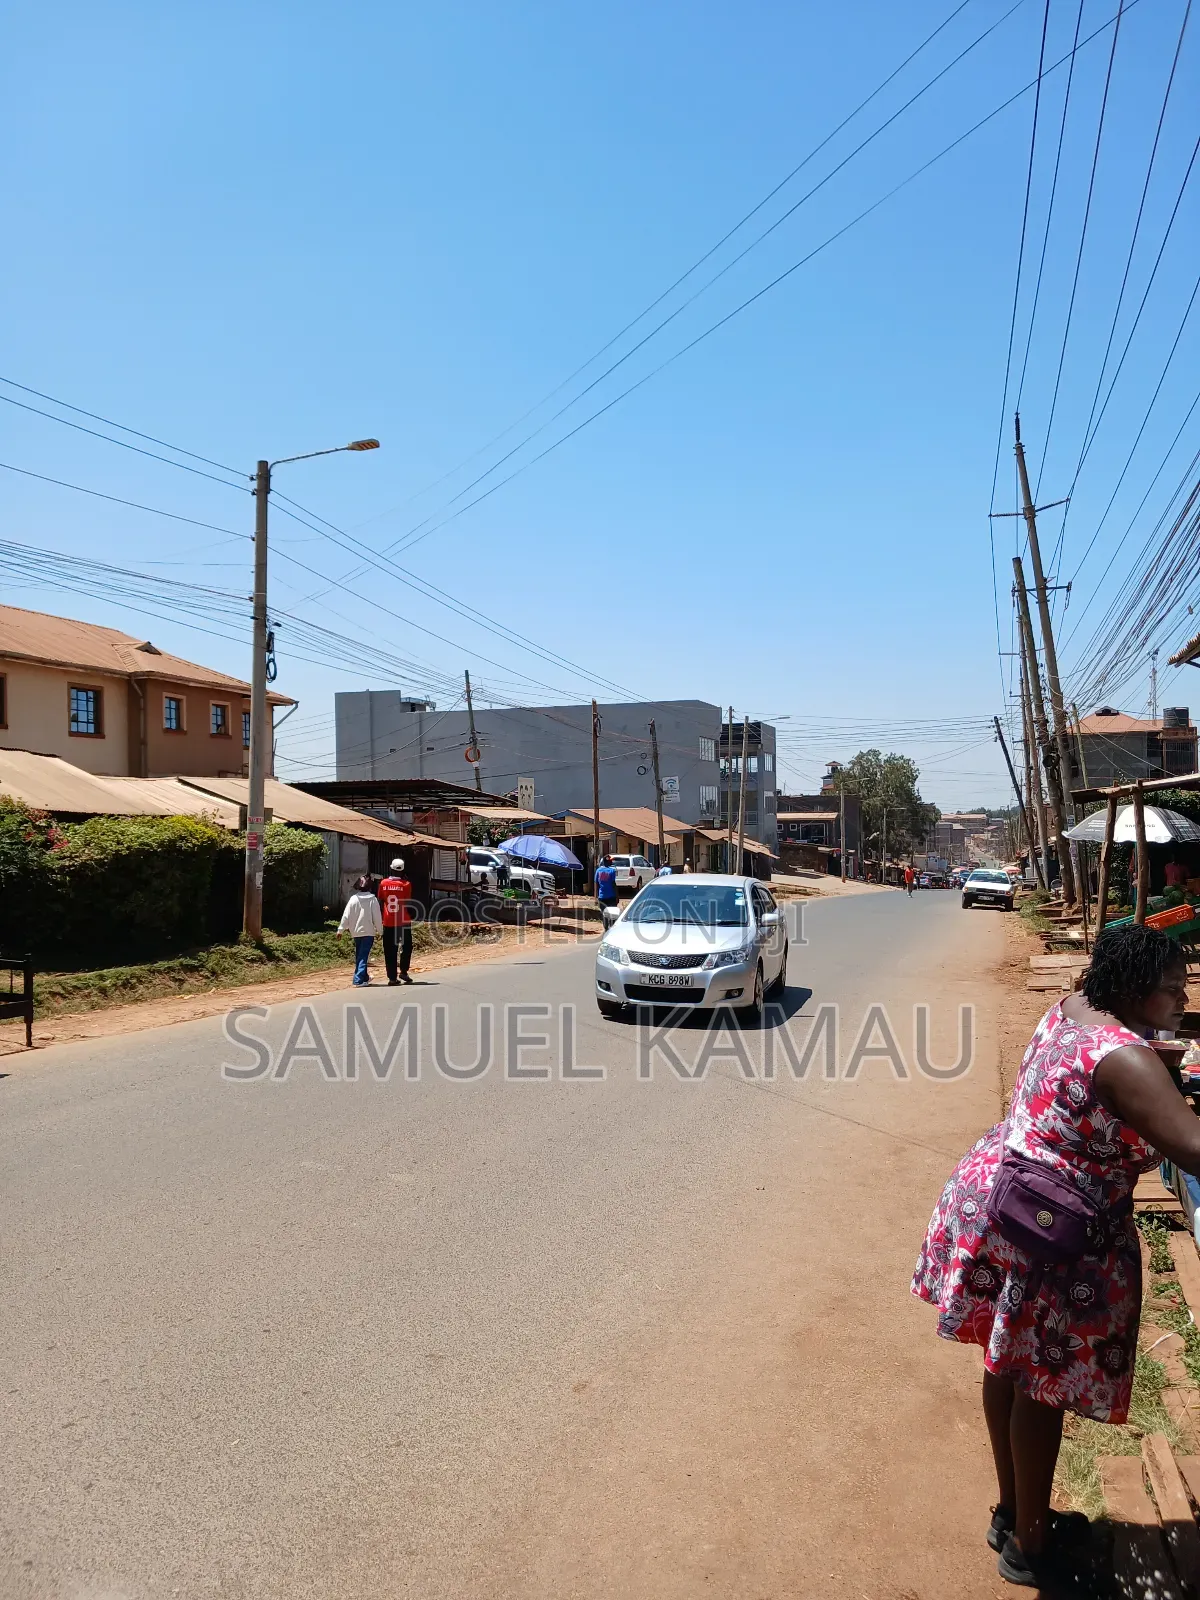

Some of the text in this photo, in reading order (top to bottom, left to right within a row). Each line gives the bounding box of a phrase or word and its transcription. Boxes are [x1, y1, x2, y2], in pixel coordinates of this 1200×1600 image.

[387, 894, 400, 913] 8
[648, 974, 690, 986] KCG 898W
